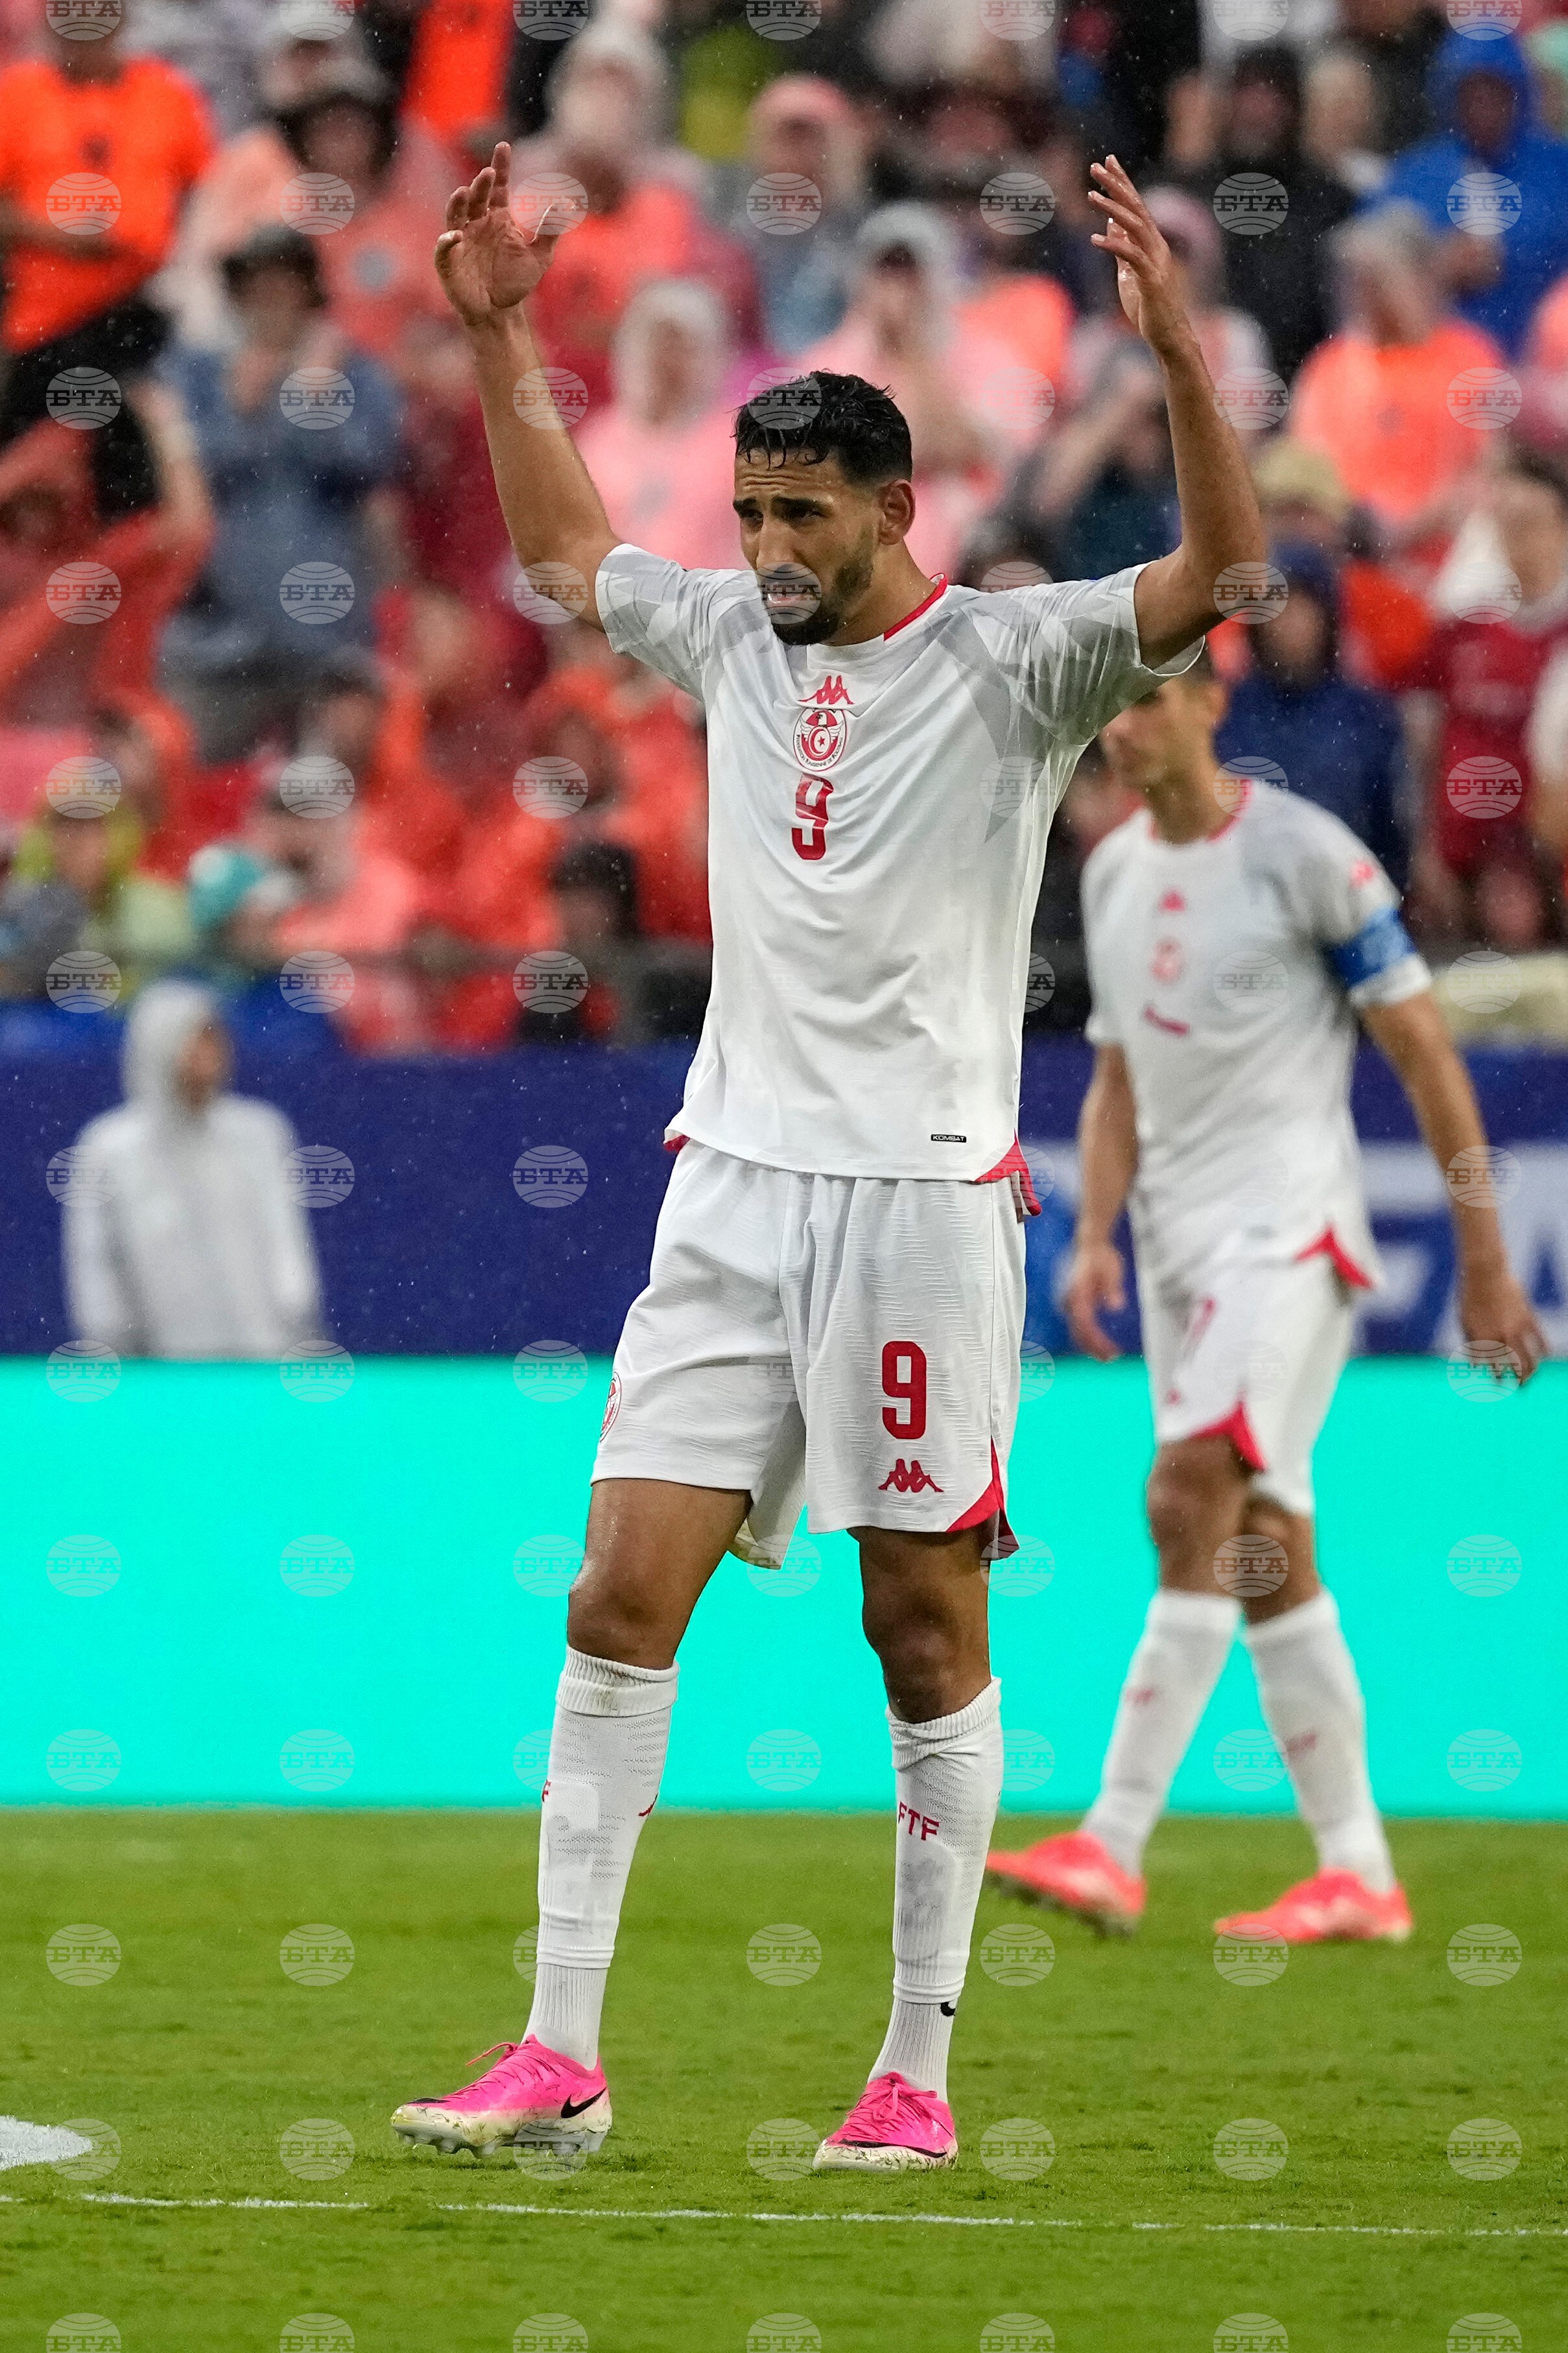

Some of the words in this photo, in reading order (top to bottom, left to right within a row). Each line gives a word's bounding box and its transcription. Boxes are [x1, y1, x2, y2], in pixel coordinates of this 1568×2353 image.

[791, 772, 834, 860] 9
[882, 1341, 927, 1439] 9
[898, 1801, 940, 1841] FTF
